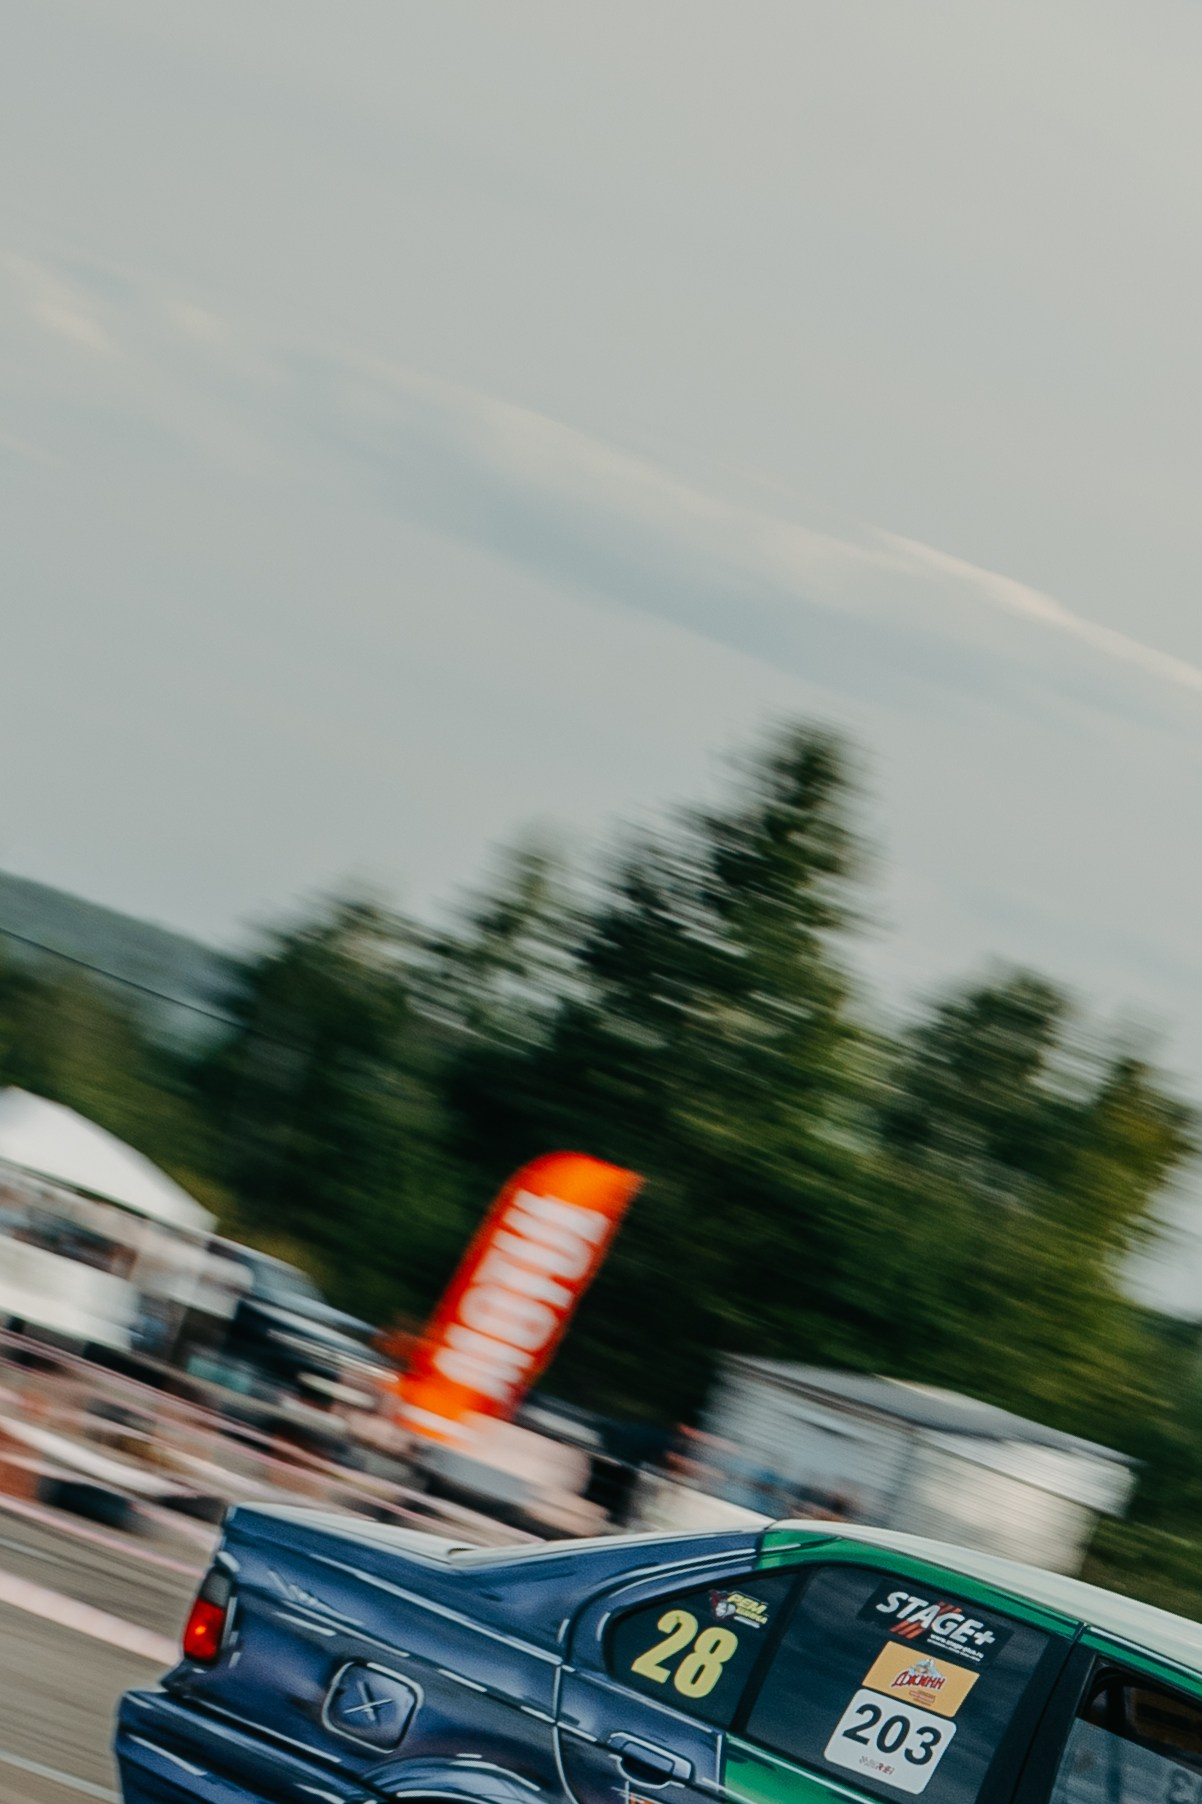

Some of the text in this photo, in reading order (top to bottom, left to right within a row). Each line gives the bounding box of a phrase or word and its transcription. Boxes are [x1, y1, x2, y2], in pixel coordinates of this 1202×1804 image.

[875, 1591, 996, 1646] STAGE+
[631, 1609, 738, 1698] 28
[842, 1703, 942, 1766] 203
